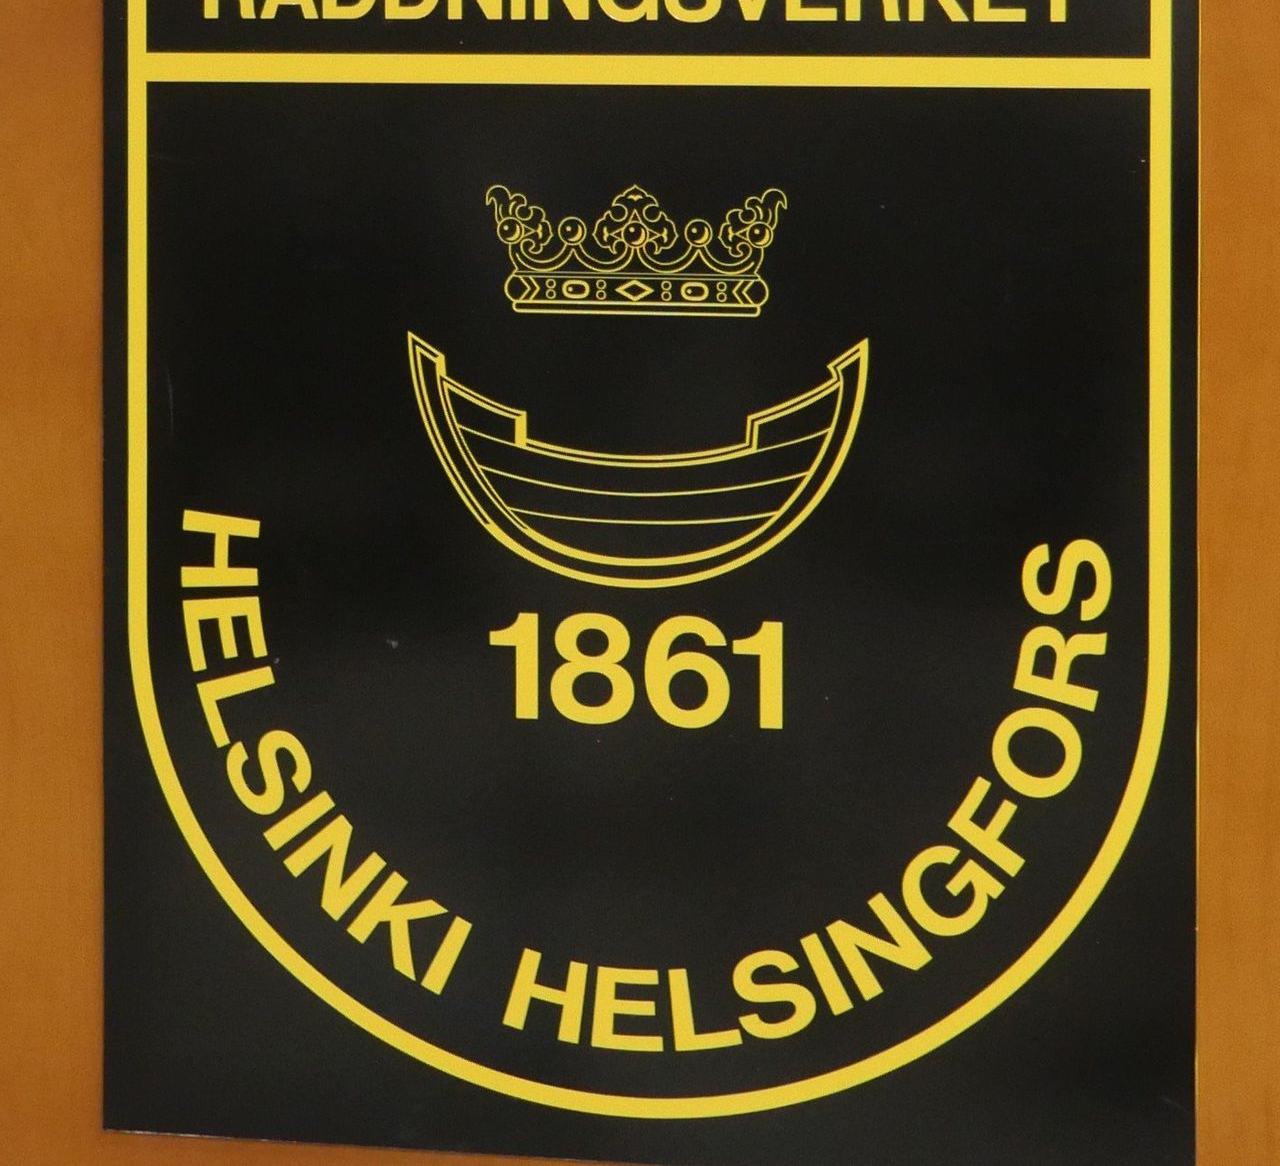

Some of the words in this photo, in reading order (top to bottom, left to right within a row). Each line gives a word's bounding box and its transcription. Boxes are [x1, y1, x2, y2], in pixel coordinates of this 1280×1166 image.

[180, 509, 473, 995] HELSINKI
[502, 538, 1112, 1053] HELSINGFORS
[489, 612, 784, 730] 1861
